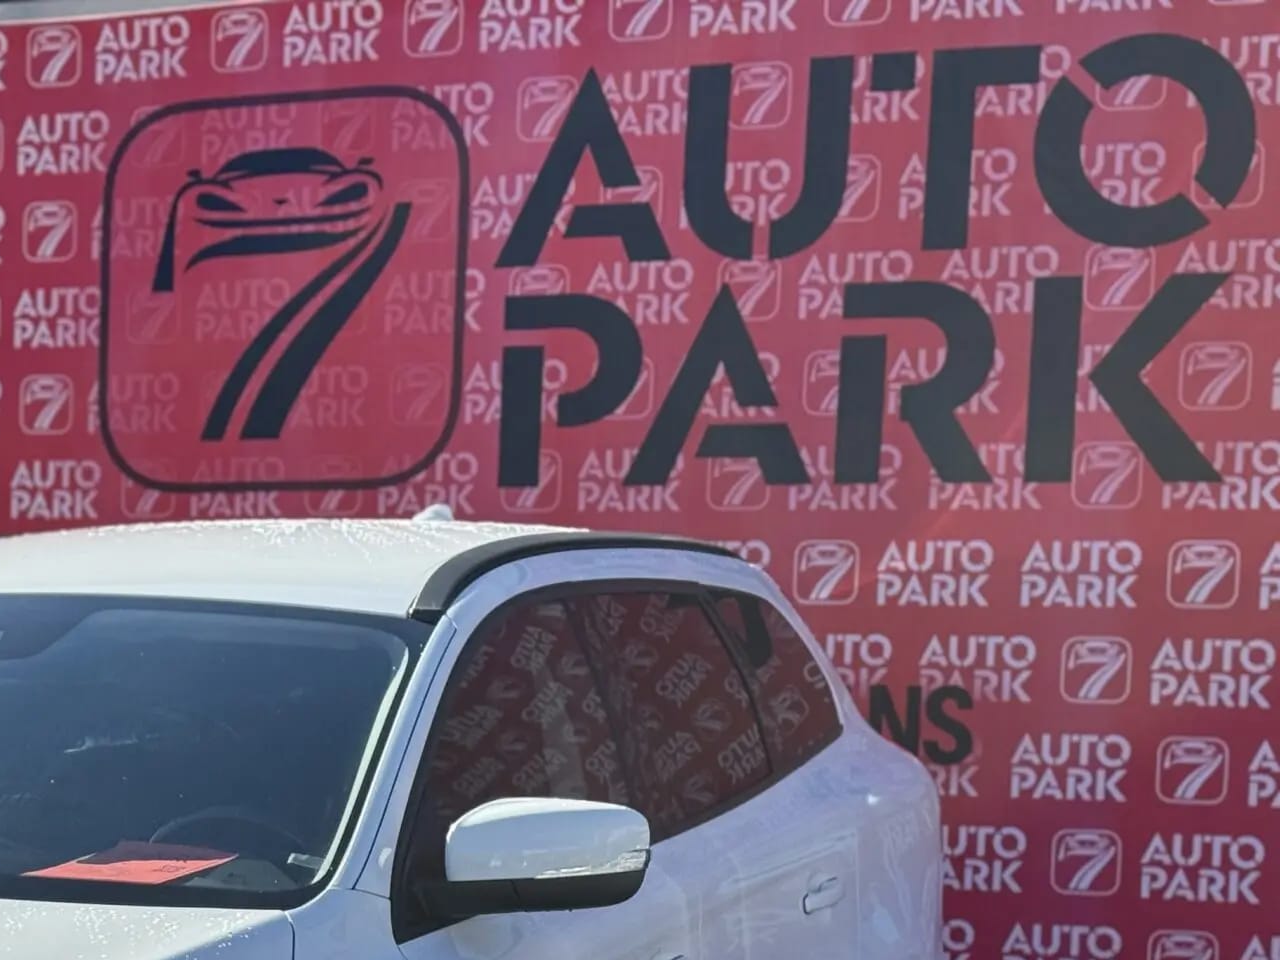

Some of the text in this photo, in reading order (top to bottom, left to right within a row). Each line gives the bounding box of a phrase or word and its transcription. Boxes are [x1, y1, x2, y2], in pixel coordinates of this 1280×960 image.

[96, 15, 189, 53] AUTO
[284, 1, 383, 37] AUTO
[480, 14, 581, 53] PARK
[690, 0, 796, 38] PARK
[95, 47, 186, 84] PARK
[283, 30, 379, 67] PARK
[17, 112, 109, 145] AUTO
[17, 142, 105, 175] PARK
[494, 32, 1257, 268] AUTO
[1080, 142, 1166, 177] UTO
[724, 160, 790, 192] UTO
[586, 259, 694, 293] AUTO
[798, 250, 913, 284] AUTO
[940, 245, 1059, 280] AUTO
[14, 287, 101, 319] AUTO
[14, 316, 99, 350] PARK
[498, 271, 1235, 487] PARK
[11, 461, 101, 491] AUTO
[11, 488, 97, 519] PARK
[878, 540, 993, 573] AUTO
[1022, 540, 1142, 574] AUTO
[877, 574, 989, 607] PARK
[1020, 575, 1136, 609] PARK
[920, 635, 1036, 668] AUTO
[1151, 639, 1275, 673] AUTO
[1150, 675, 1270, 709] PARK
[1012, 734, 1131, 766] AUTO
[1011, 769, 1126, 802] PARK
[1141, 833, 1265, 869] AUTO
[1141, 867, 1260, 904] PARK
[1002, 923, 1122, 960] AUTO
